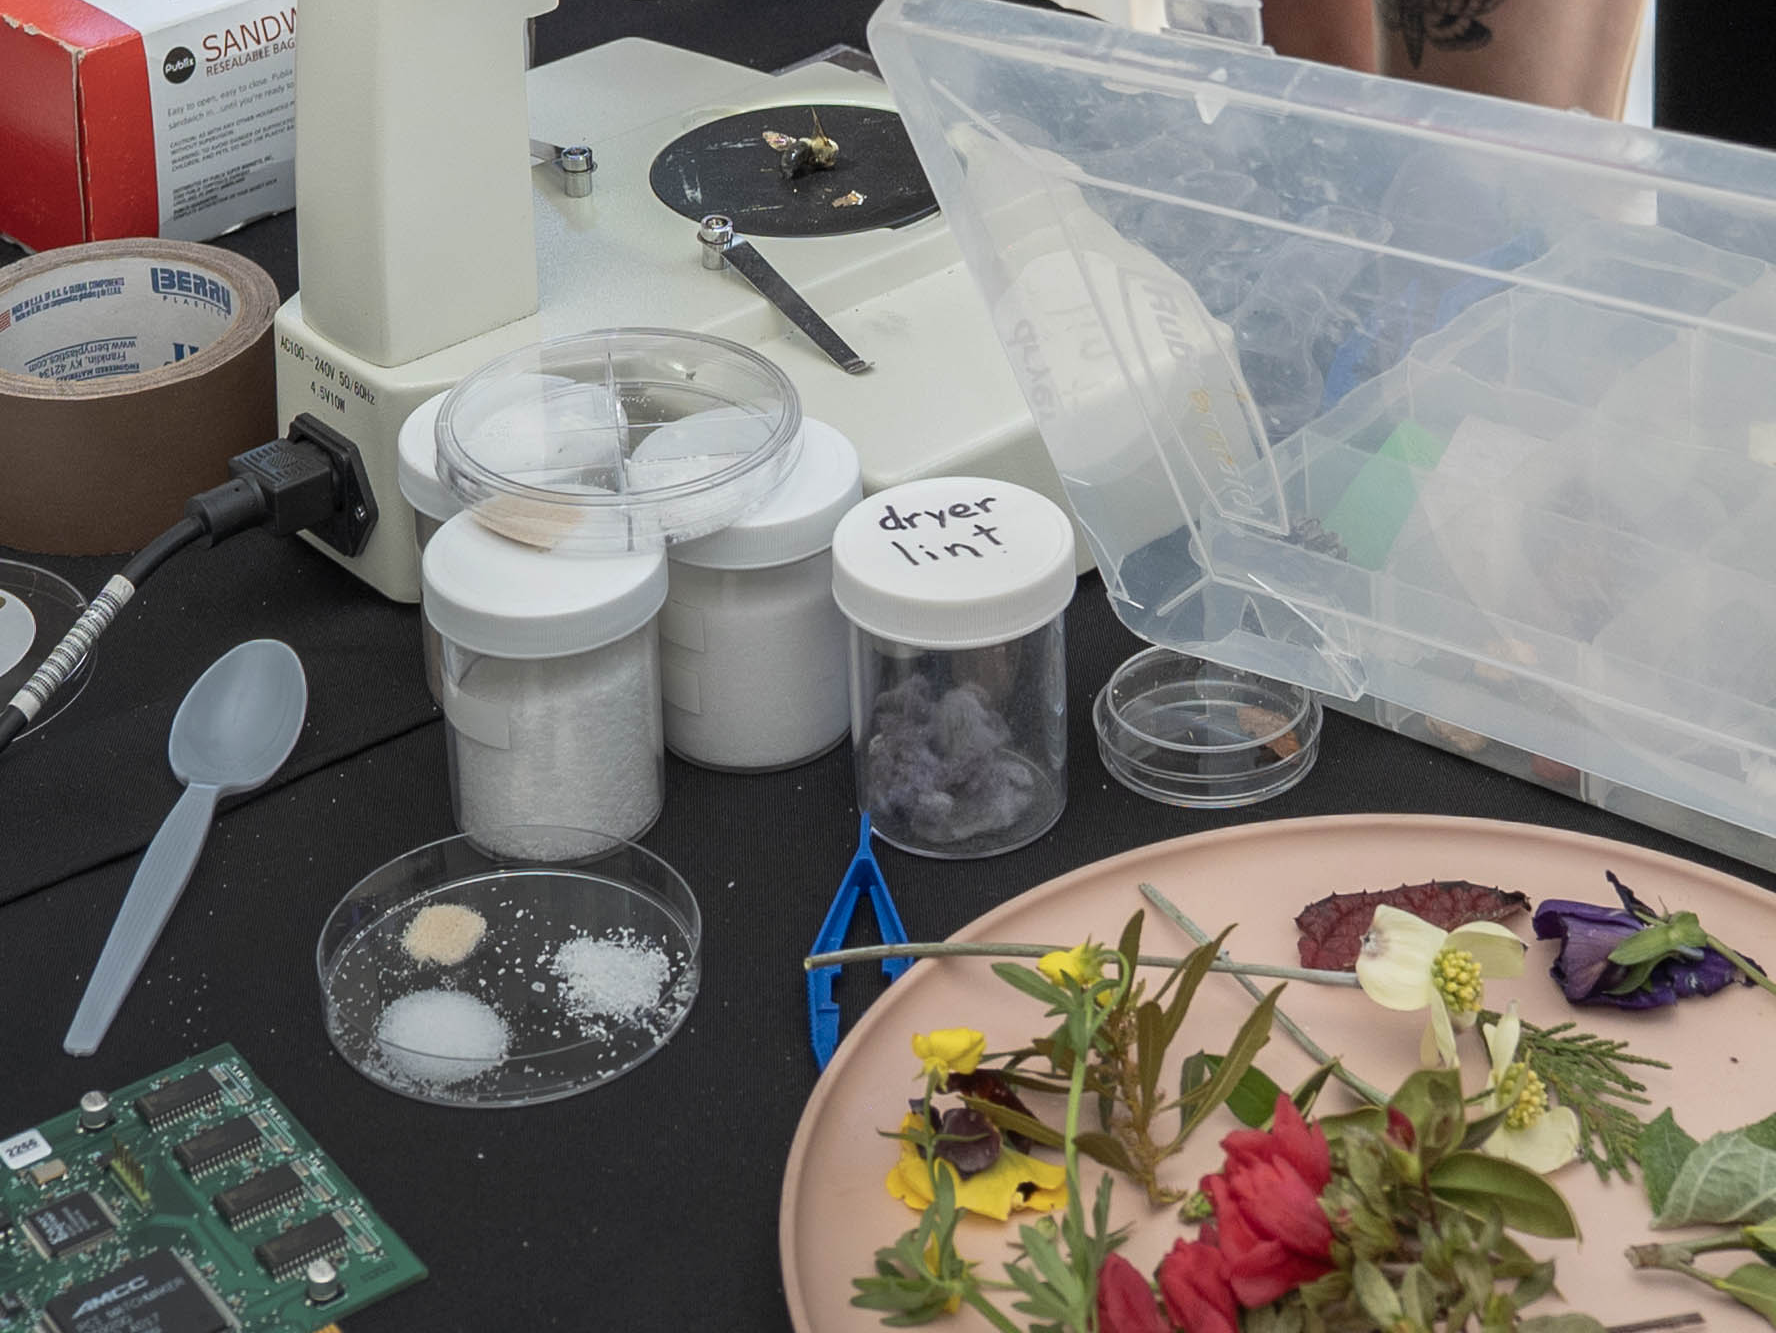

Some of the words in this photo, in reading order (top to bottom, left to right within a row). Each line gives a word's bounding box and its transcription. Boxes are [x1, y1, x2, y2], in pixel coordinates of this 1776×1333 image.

[205, 45, 271, 77] RESEALABLE
[27, 338, 137, 374] www.berryplastics.com
[67, 358, 82, 371] KY
[338, 369, 376, 406] 50/60Hz
[879, 496, 997, 531] dryer
[891, 523, 1003, 566] lint
